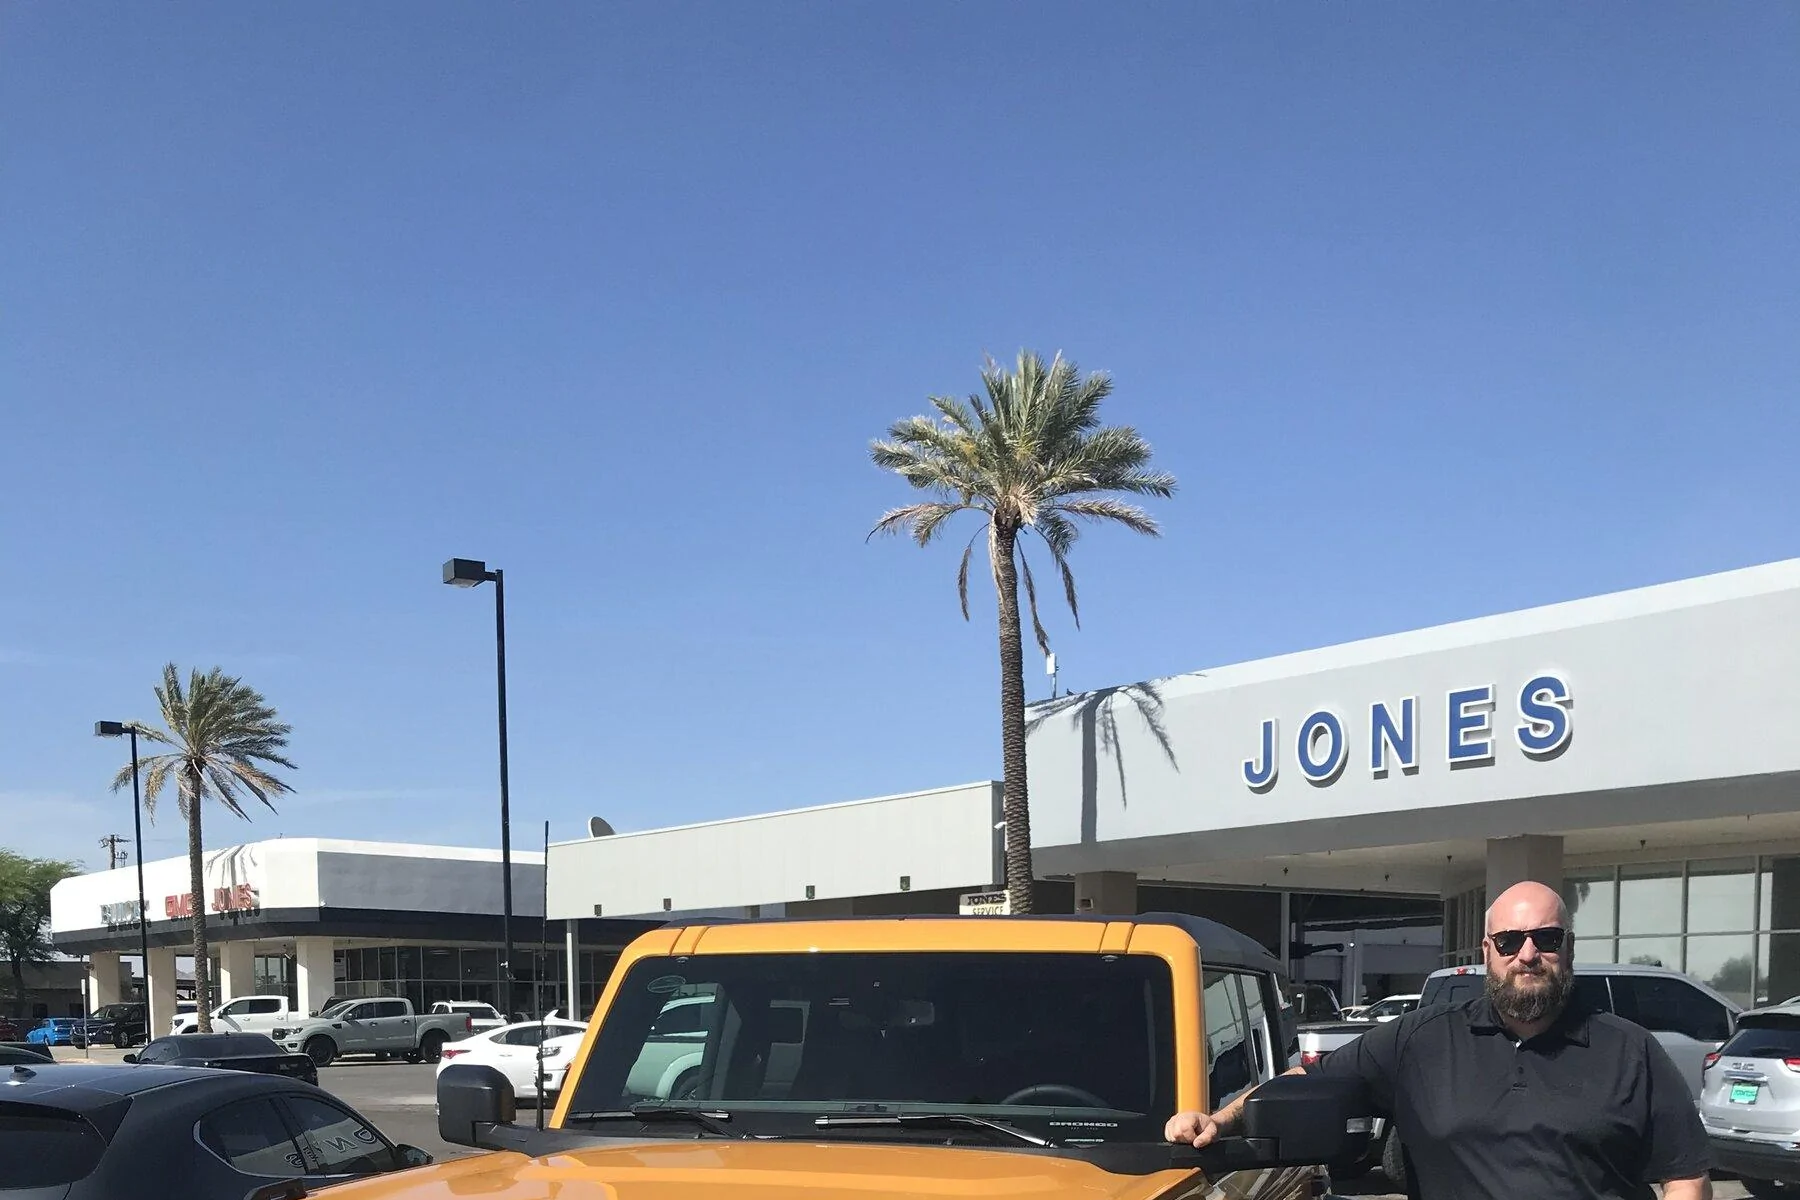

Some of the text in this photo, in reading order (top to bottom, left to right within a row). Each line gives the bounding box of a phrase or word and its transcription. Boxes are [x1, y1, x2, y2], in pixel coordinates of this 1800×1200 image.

[1242, 674, 1572, 788] JONES
[211, 883, 254, 912] JONES
[967, 893, 1006, 905] JONES
[972, 906, 1003, 915] SERVICE
